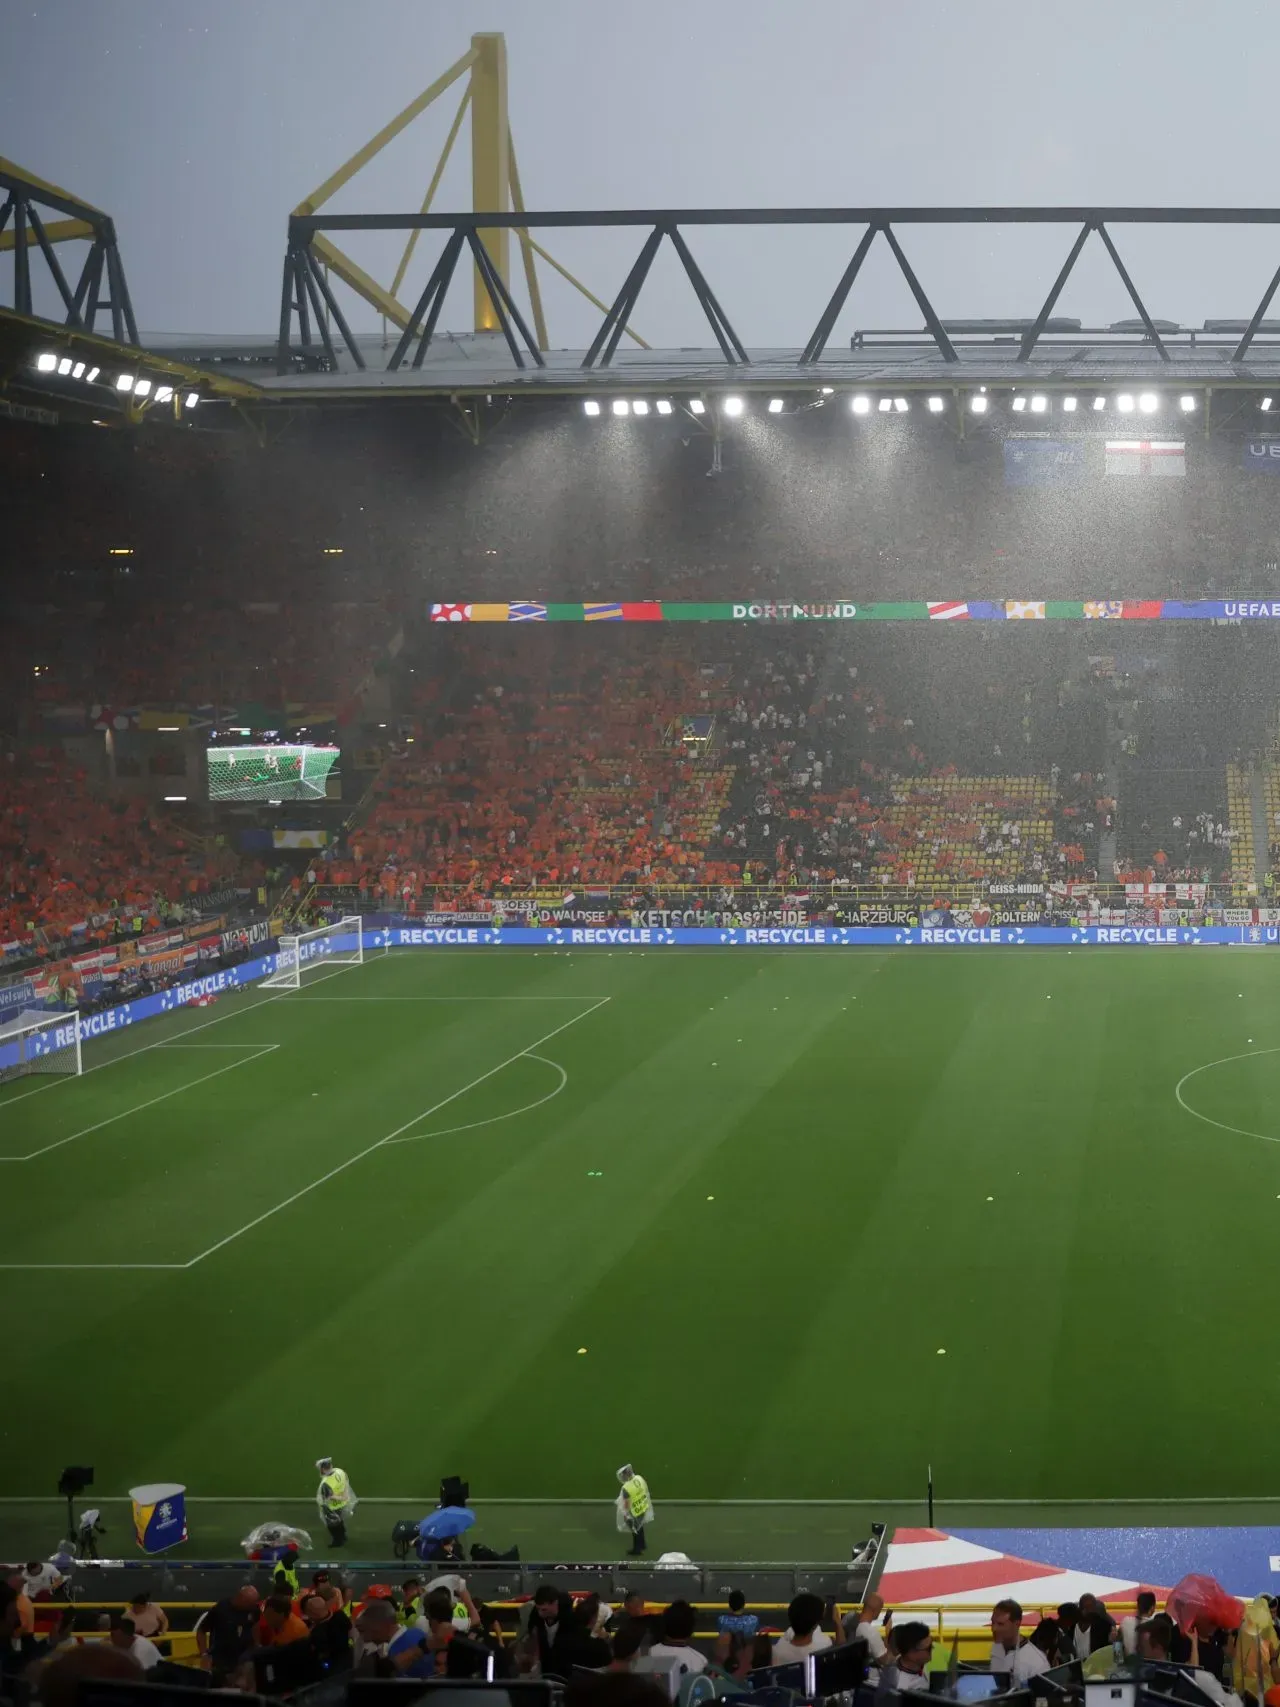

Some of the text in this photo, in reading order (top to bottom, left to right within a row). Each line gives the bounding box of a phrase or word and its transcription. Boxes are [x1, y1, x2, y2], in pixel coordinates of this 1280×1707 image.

[733, 604, 857, 618] DORTMUND
[400, 929, 478, 943] RECYCLE
[572, 929, 651, 943] RECYCLE
[745, 929, 825, 943] RECYCLE
[921, 929, 1001, 943] RECYCLE
[1097, 929, 1177, 942] RECYCLE
[275, 942, 316, 969] RECCLE
[177, 973, 226, 1003] RECYCLE
[56, 1011, 116, 1048] RECYCLE
